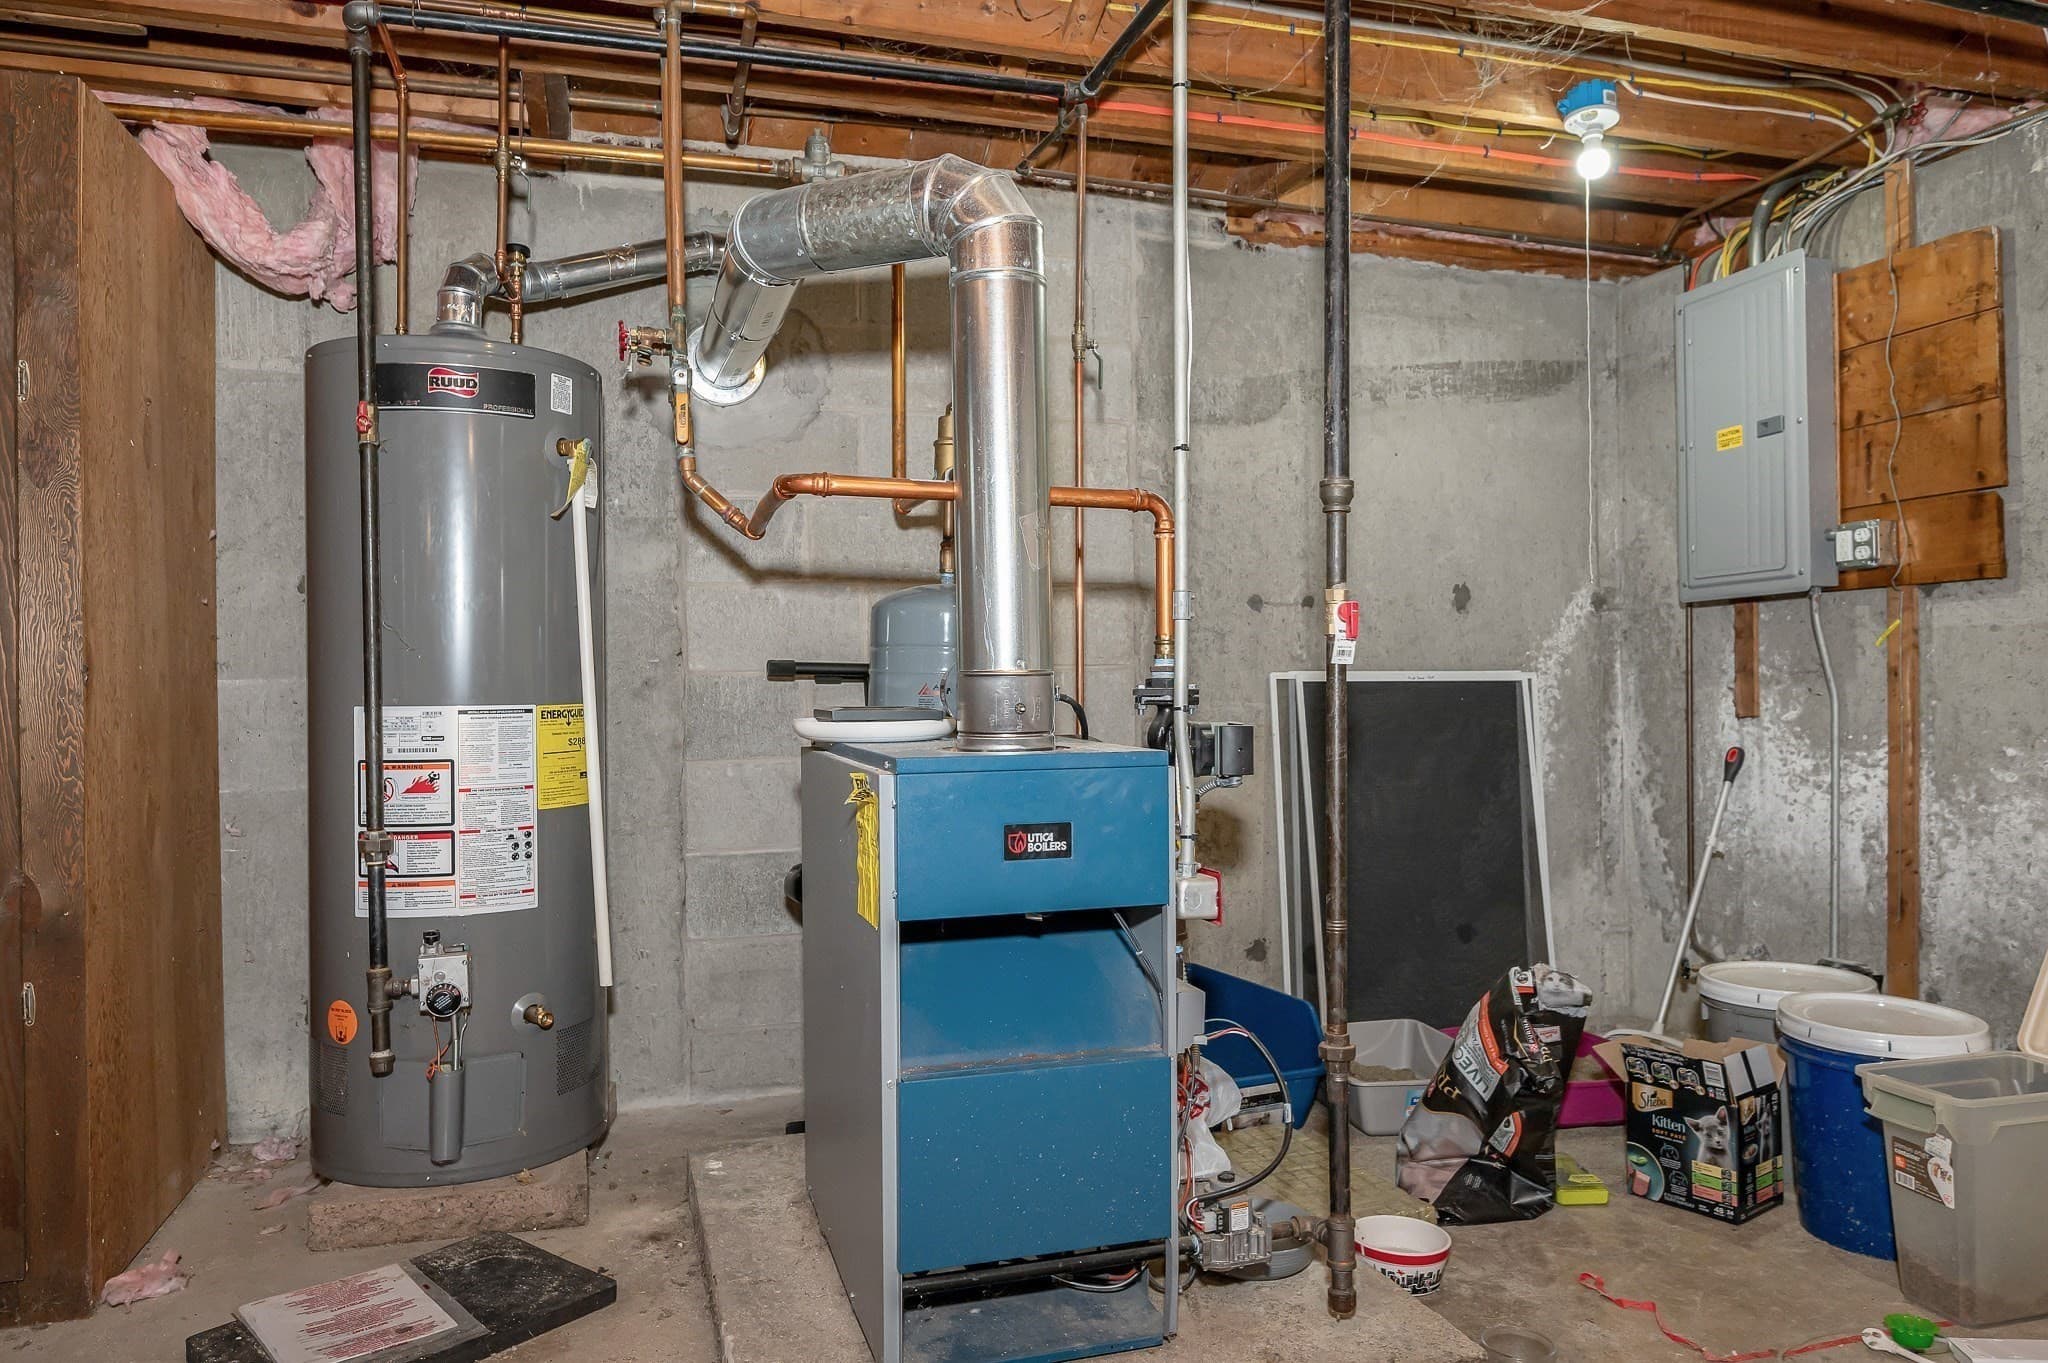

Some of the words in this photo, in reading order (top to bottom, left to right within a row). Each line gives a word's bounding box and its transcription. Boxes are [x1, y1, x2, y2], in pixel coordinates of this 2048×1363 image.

[429, 376, 478, 389] RUUD
[483, 403, 534, 415] PROFESSIONAL
[541, 709, 585, 721] ENERGYGUID
[1027, 832, 1054, 843] UTICA
[1027, 841, 1067, 853] BOILERS
[1640, 1090, 1666, 1109] Sheba
[1651, 1114, 1686, 1133] Kitten
